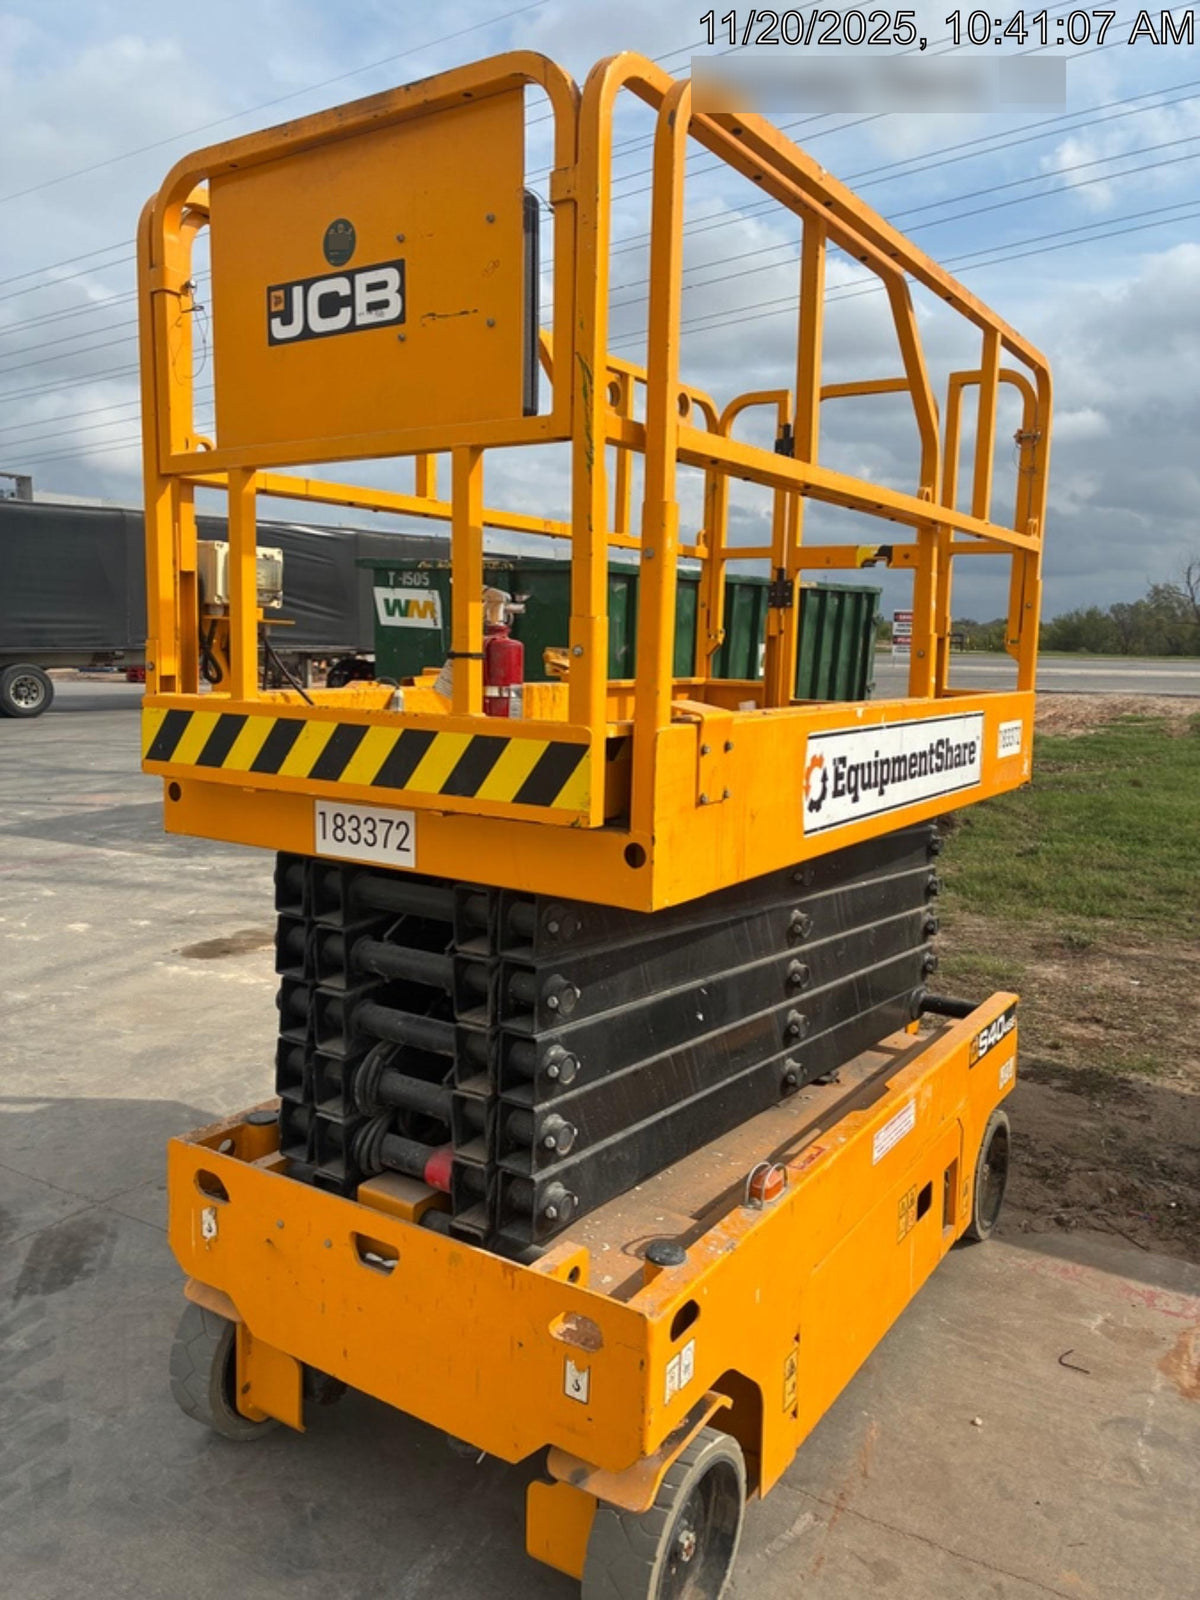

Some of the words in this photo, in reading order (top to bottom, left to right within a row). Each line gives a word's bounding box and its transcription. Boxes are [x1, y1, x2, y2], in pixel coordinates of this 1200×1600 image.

[271, 267, 402, 339] JCB
[384, 598, 436, 619] WM
[831, 737, 976, 803] EquipmentShare
[318, 811, 411, 853] 183372
